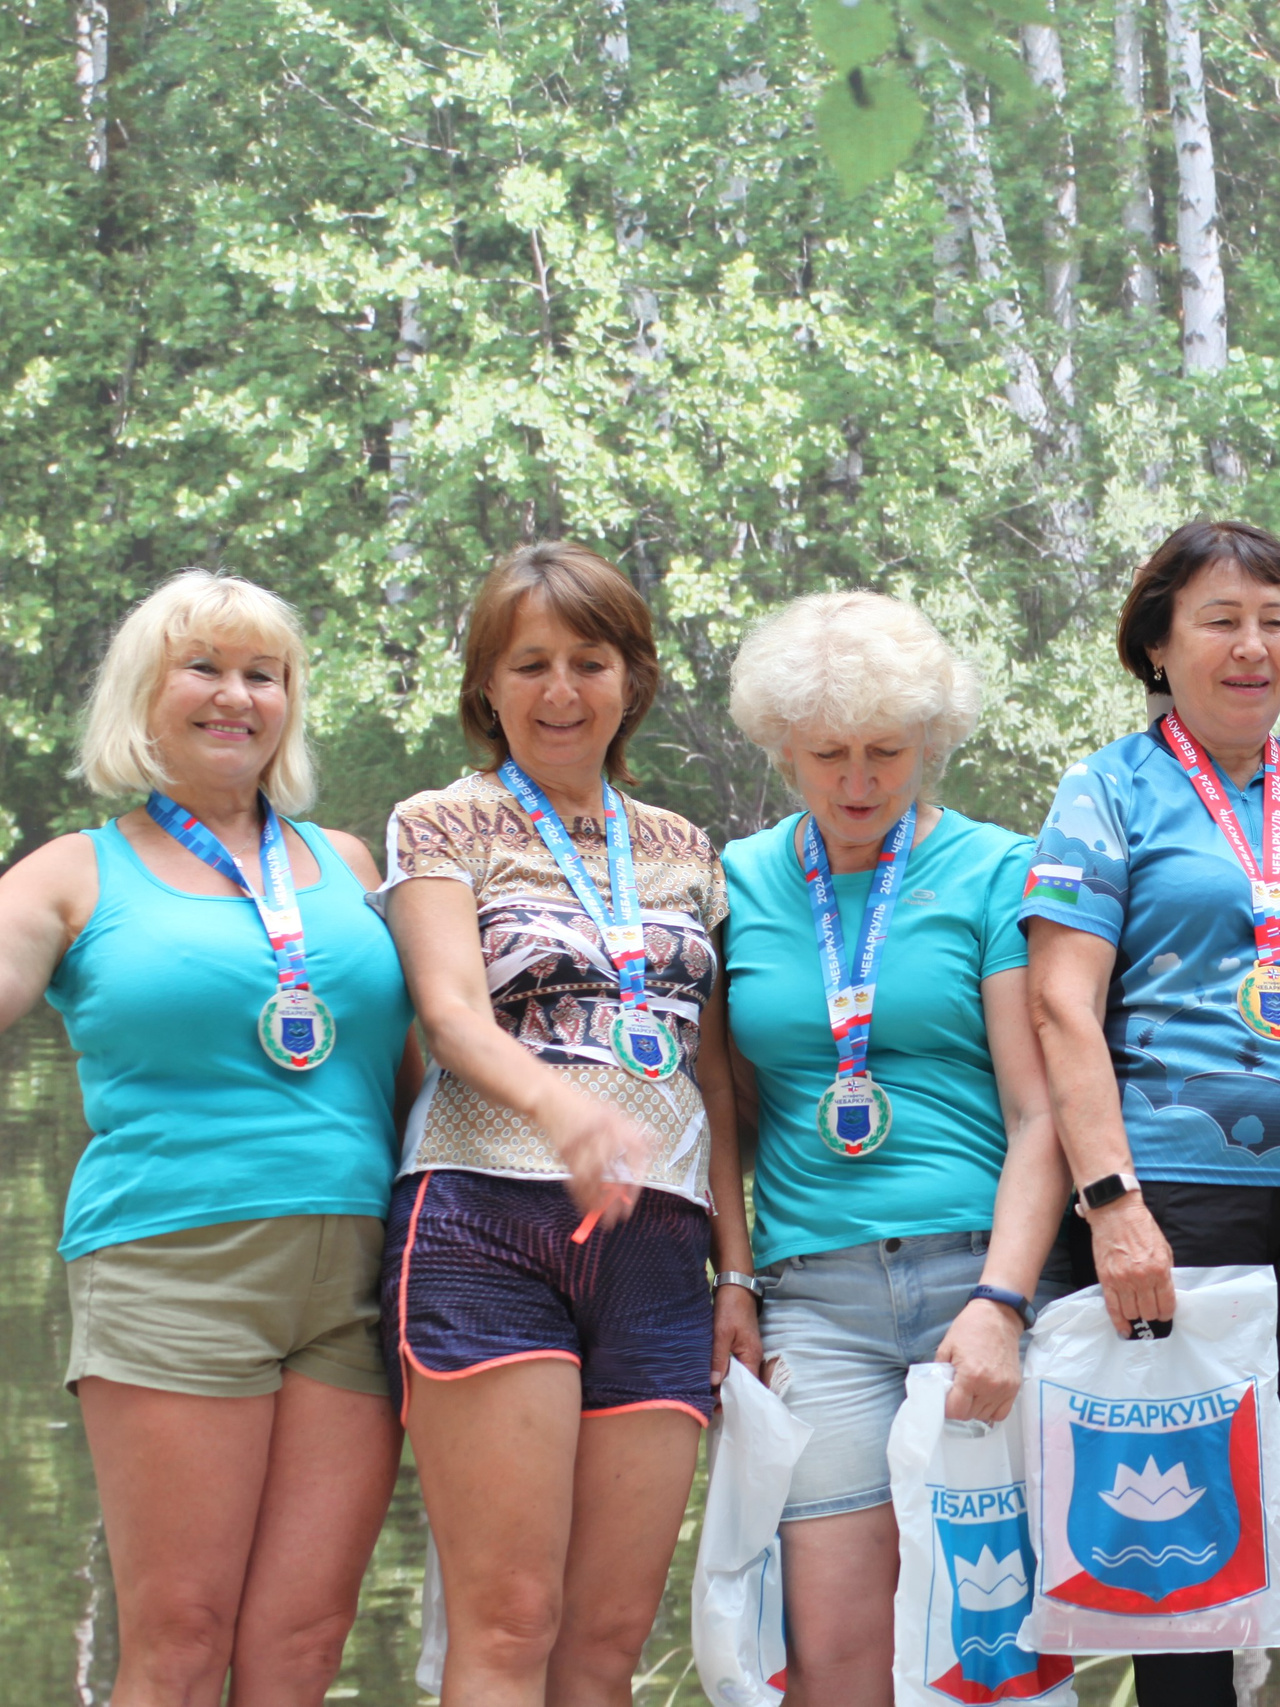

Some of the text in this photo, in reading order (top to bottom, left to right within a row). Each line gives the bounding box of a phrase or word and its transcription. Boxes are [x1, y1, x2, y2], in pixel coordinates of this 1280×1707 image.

[1198, 774, 1220, 801] 2024
[543, 816, 564, 846] 2024
[613, 821, 623, 849] 2024
[1219, 808, 1256, 876] ЧЕБАРКУЛЬ
[563, 852, 605, 922] ЧЕБАРКУЛЬ
[615, 856, 632, 921] ЧЕБАРКУЛЬ
[815, 874, 828, 905] 2024
[859, 903, 886, 979] ЧЕБАРКУЛЬ
[880, 865, 897, 895] 2024
[820, 911, 842, 987] ЧЕБАРКУЛЬ
[834, 1097, 874, 1105] ЧЕБАРКУЛЬ
[1068, 1392, 1240, 1428] ЧЕБАРКУЛЬ
